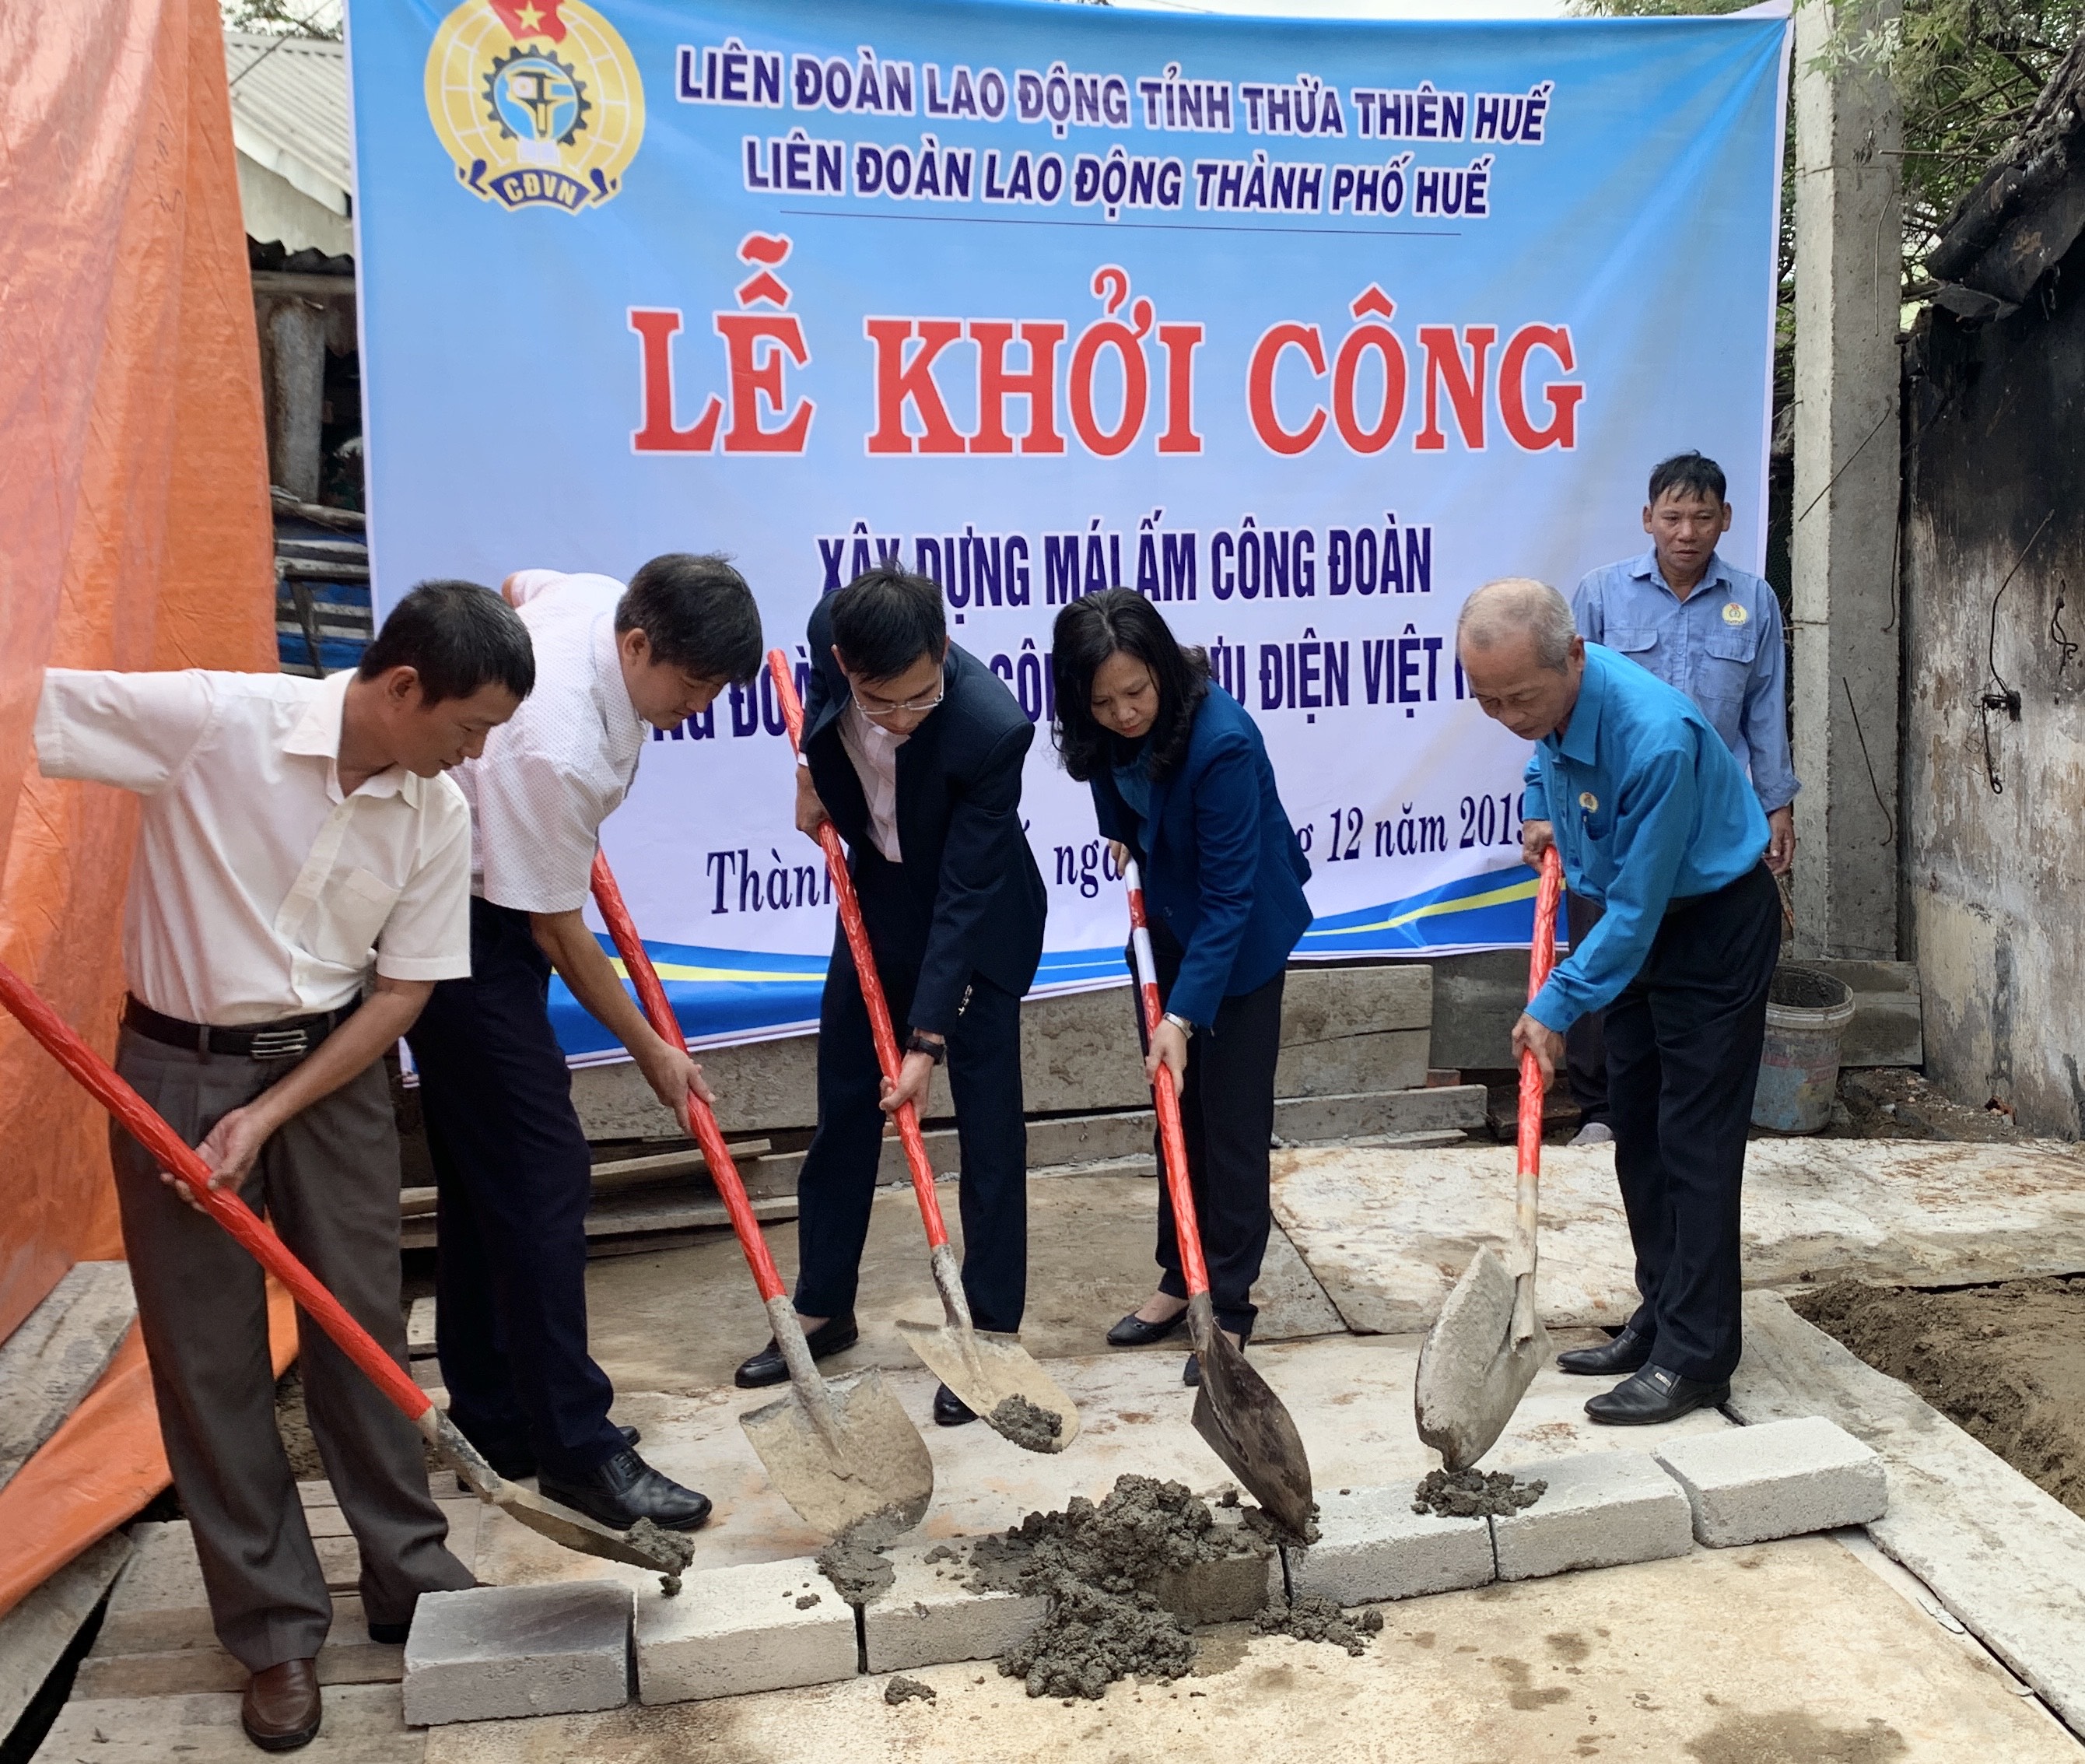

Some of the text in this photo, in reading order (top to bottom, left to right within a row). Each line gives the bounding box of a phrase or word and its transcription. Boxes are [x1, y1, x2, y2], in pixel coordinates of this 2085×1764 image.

[681, 43, 1551, 141] LIÊN ĐOÀN LAO ĐỘNG TỈNH THỪA THIÊN HUẾ
[748, 132, 1491, 217] LIÊN ĐOÀN LAO ĐỘNG THÀNH PHỐ HUẾ
[633, 236, 1584, 456] LỄ KHỞI CÔNG
[1044, 518, 1124, 605] MÁI
[1136, 509, 1197, 601] ẤM
[1211, 515, 1316, 601] CÔNG
[1327, 513, 1431, 596] ĐOÀN
[1259, 627, 1349, 724] ĐIỆN
[1362, 623, 1443, 718] VIỆT
[1326, 806, 1364, 862] 12
[1375, 801, 1449, 857] năm
